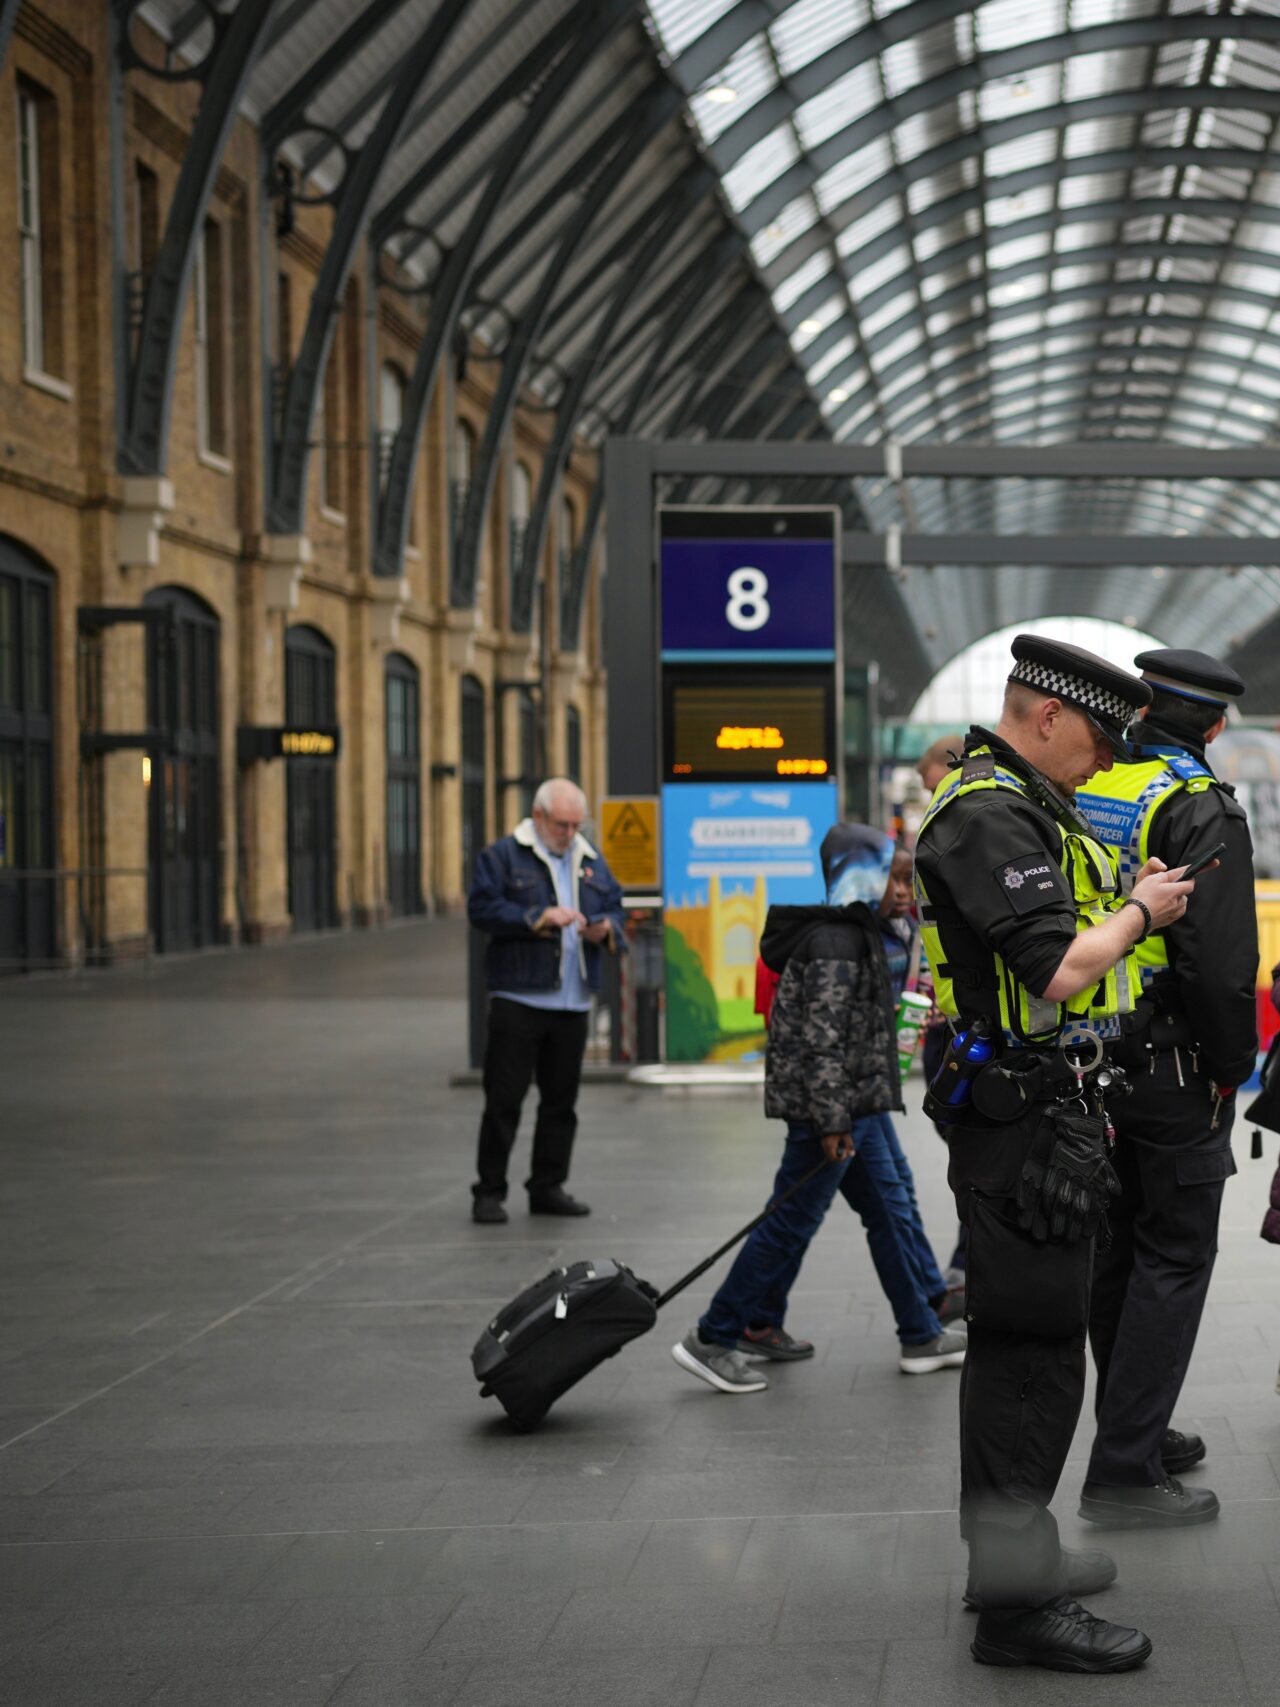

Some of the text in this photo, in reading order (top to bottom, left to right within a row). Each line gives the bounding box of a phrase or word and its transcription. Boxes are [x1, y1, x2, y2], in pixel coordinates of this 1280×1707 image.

[725, 566, 771, 632] 8
[1114, 804, 1137, 814] POLICE
[1082, 808, 1133, 827] COMMUNITY
[1024, 866, 1051, 877] POLICE
